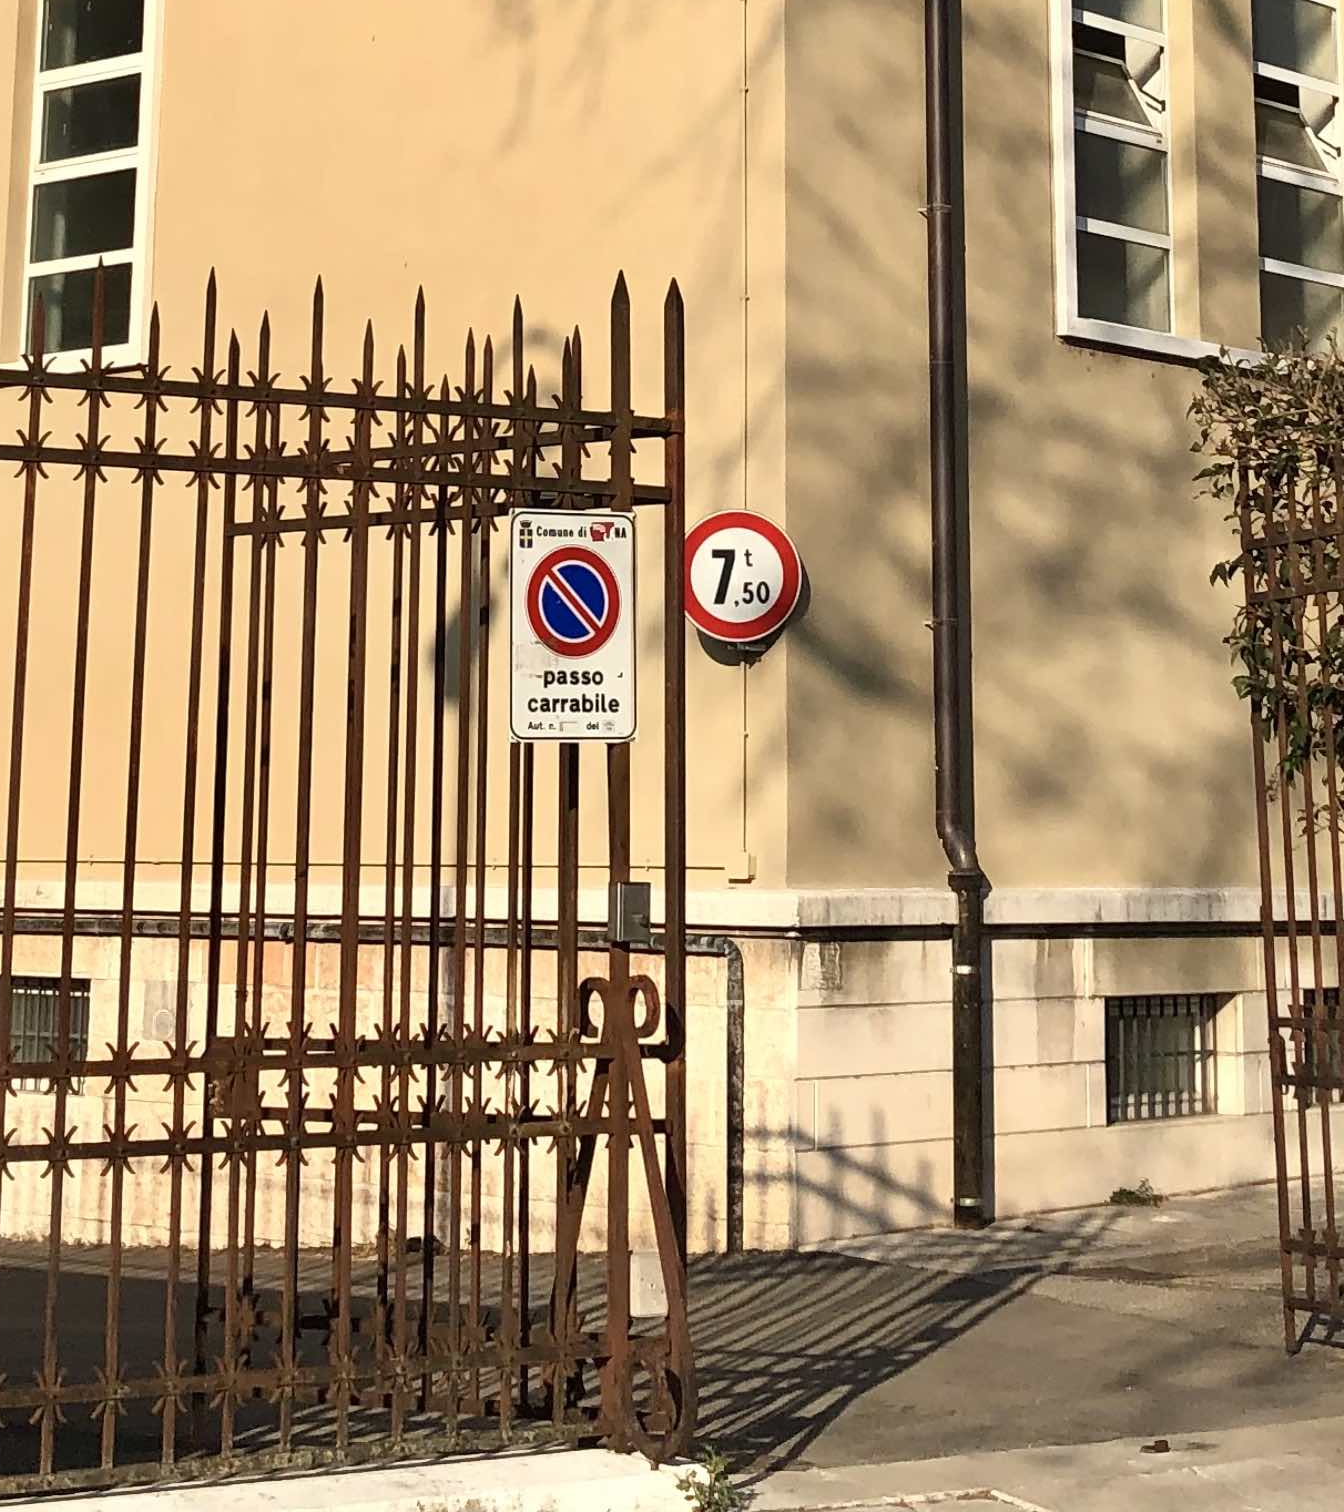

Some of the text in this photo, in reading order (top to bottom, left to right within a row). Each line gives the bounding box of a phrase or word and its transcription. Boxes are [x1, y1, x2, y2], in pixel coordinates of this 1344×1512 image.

[536, 526, 574, 537] Comune
[578, 527, 587, 538] di
[743, 549, 753, 567] t
[543, 670, 604, 688] passo
[527, 693, 620, 713] carrabile
